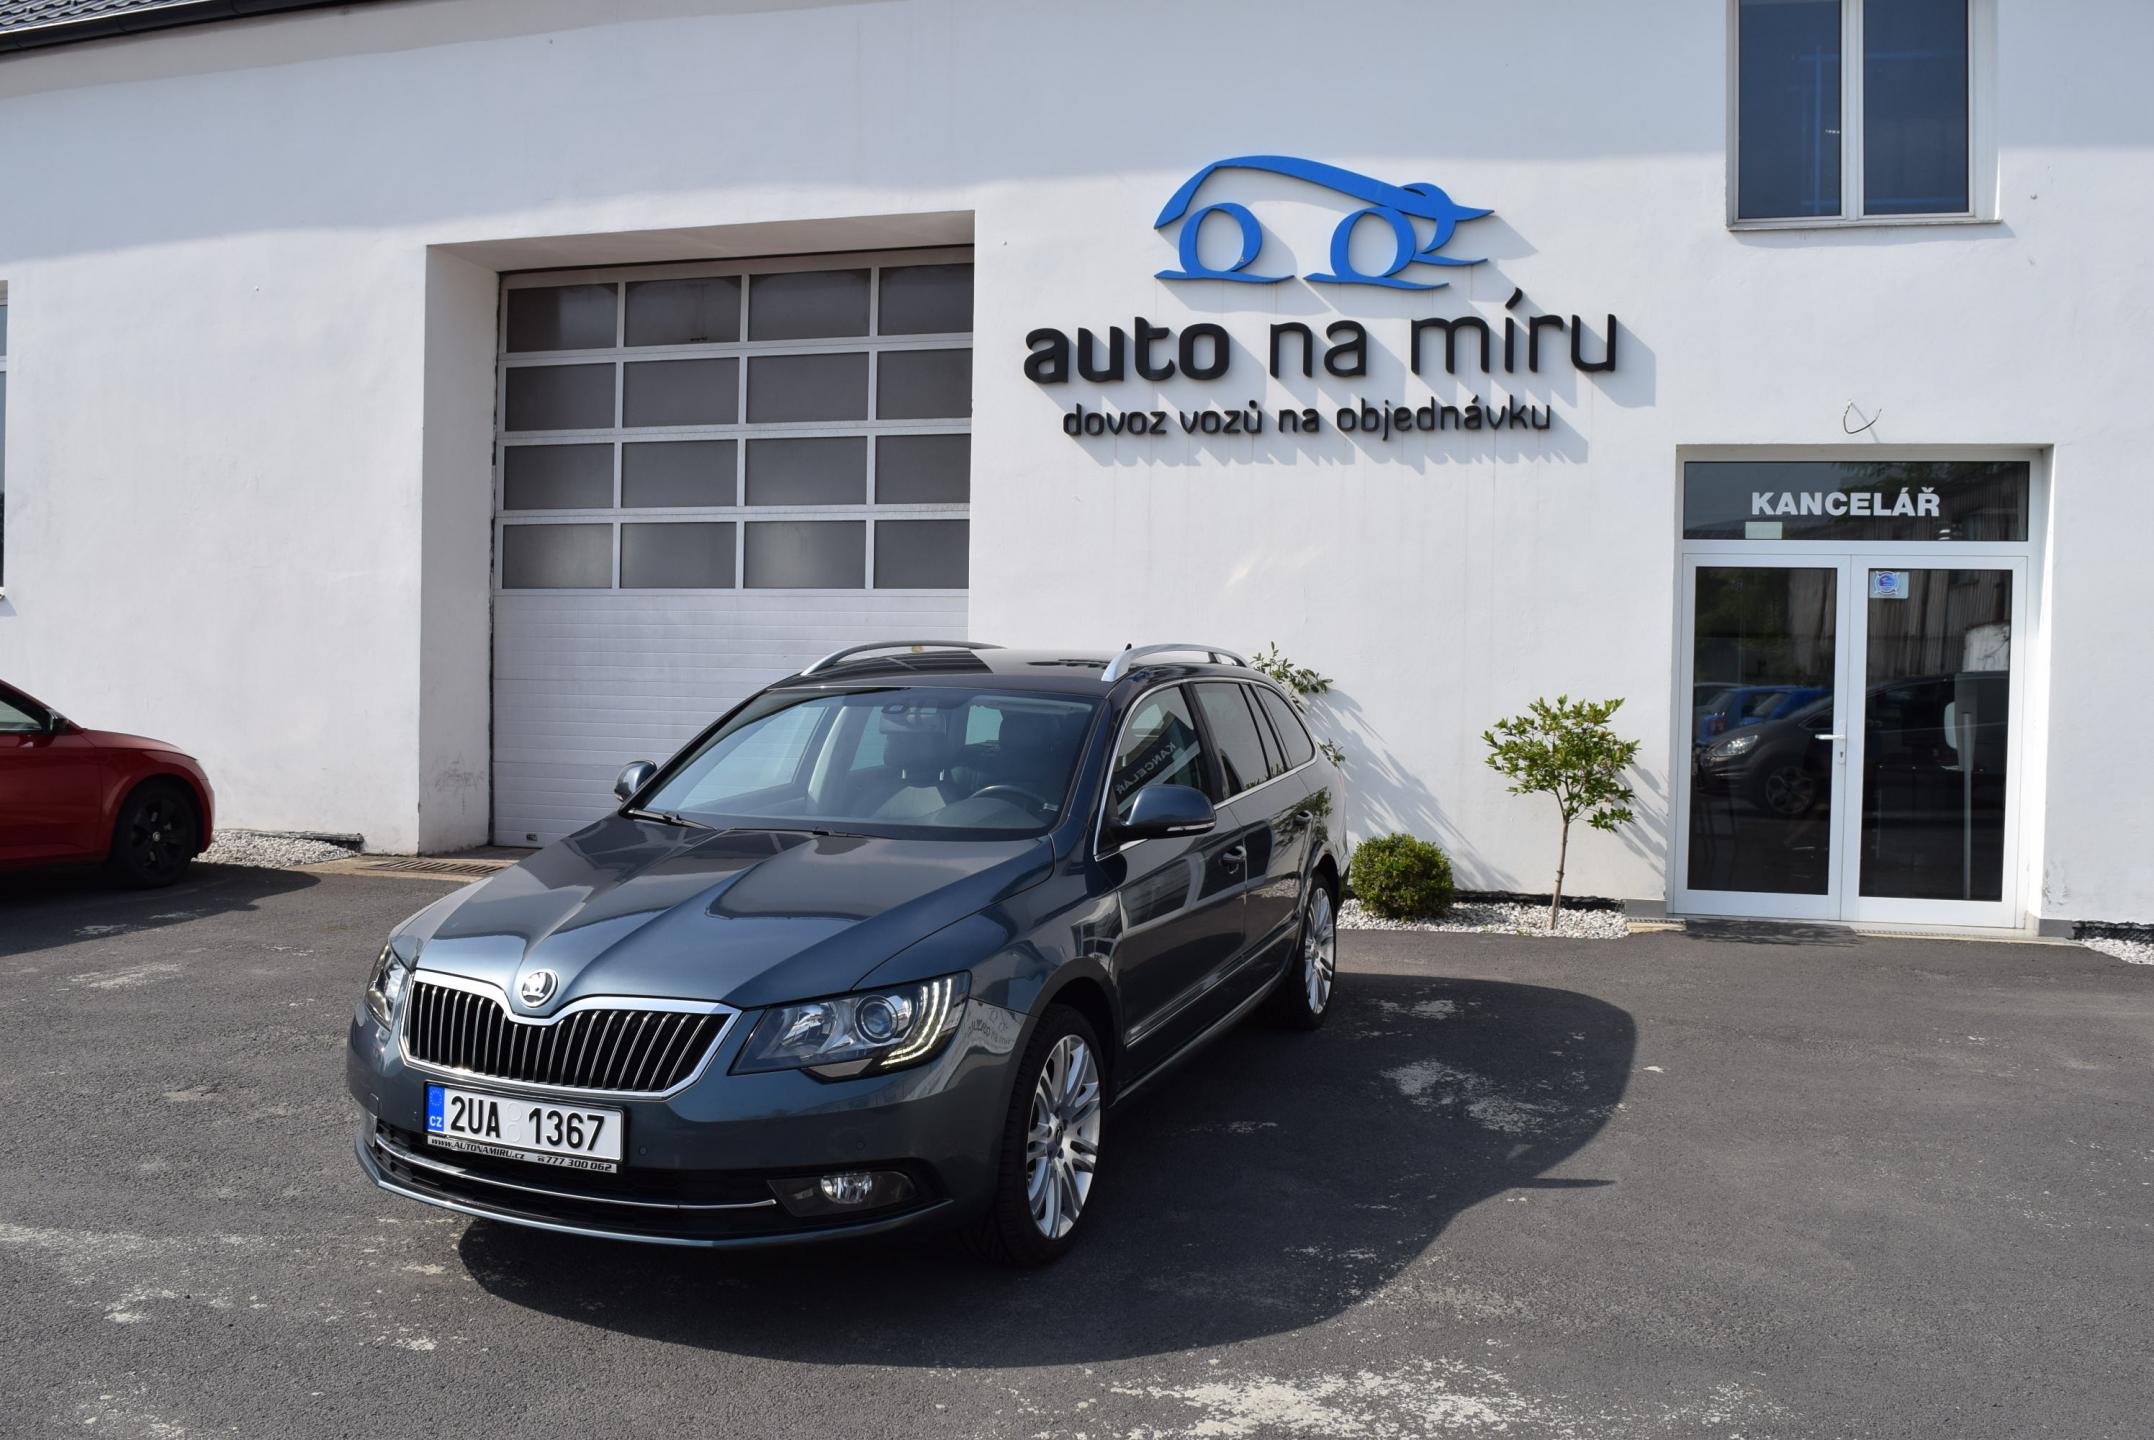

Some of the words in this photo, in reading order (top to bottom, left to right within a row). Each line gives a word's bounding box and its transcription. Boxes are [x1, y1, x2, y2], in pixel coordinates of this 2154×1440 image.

[1023, 316, 1231, 385] auto
[1269, 320, 1368, 380] na
[1410, 287, 1618, 376] míru
[1063, 403, 1168, 438] dovoz
[1179, 399, 1264, 436] vozů
[1278, 408, 1321, 434] na
[1336, 394, 1551, 442] objednávku
[1750, 486, 1941, 518] KANCELÁŘ
[429, 1115, 443, 1128] CZ
[450, 1095, 501, 1139] 2UA
[528, 1107, 605, 1152] 1367
